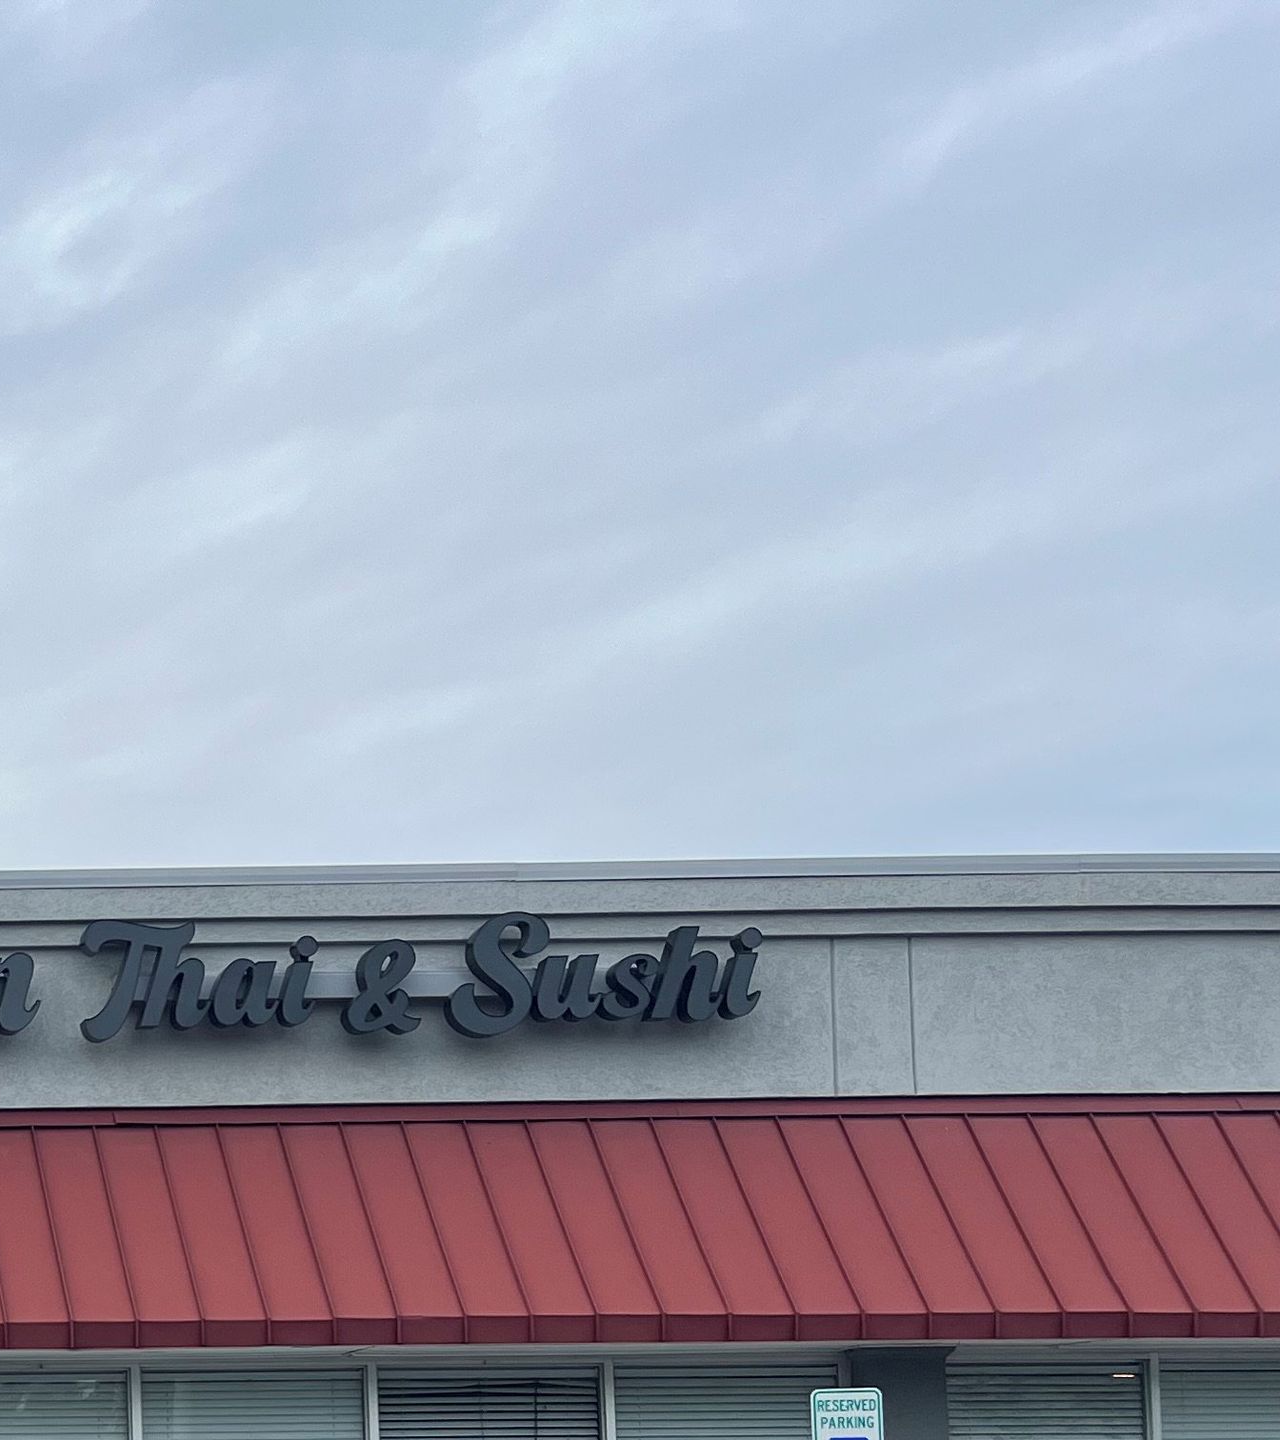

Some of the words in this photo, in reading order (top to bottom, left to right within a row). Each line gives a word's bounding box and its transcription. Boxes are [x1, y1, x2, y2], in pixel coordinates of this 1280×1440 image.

[79, 919, 318, 1043] Thai
[341, 938, 421, 1036] &
[443, 911, 763, 1038] Sushi
[817, 1399, 876, 1412] RESERVED
[821, 1416, 874, 1429] PARKING
